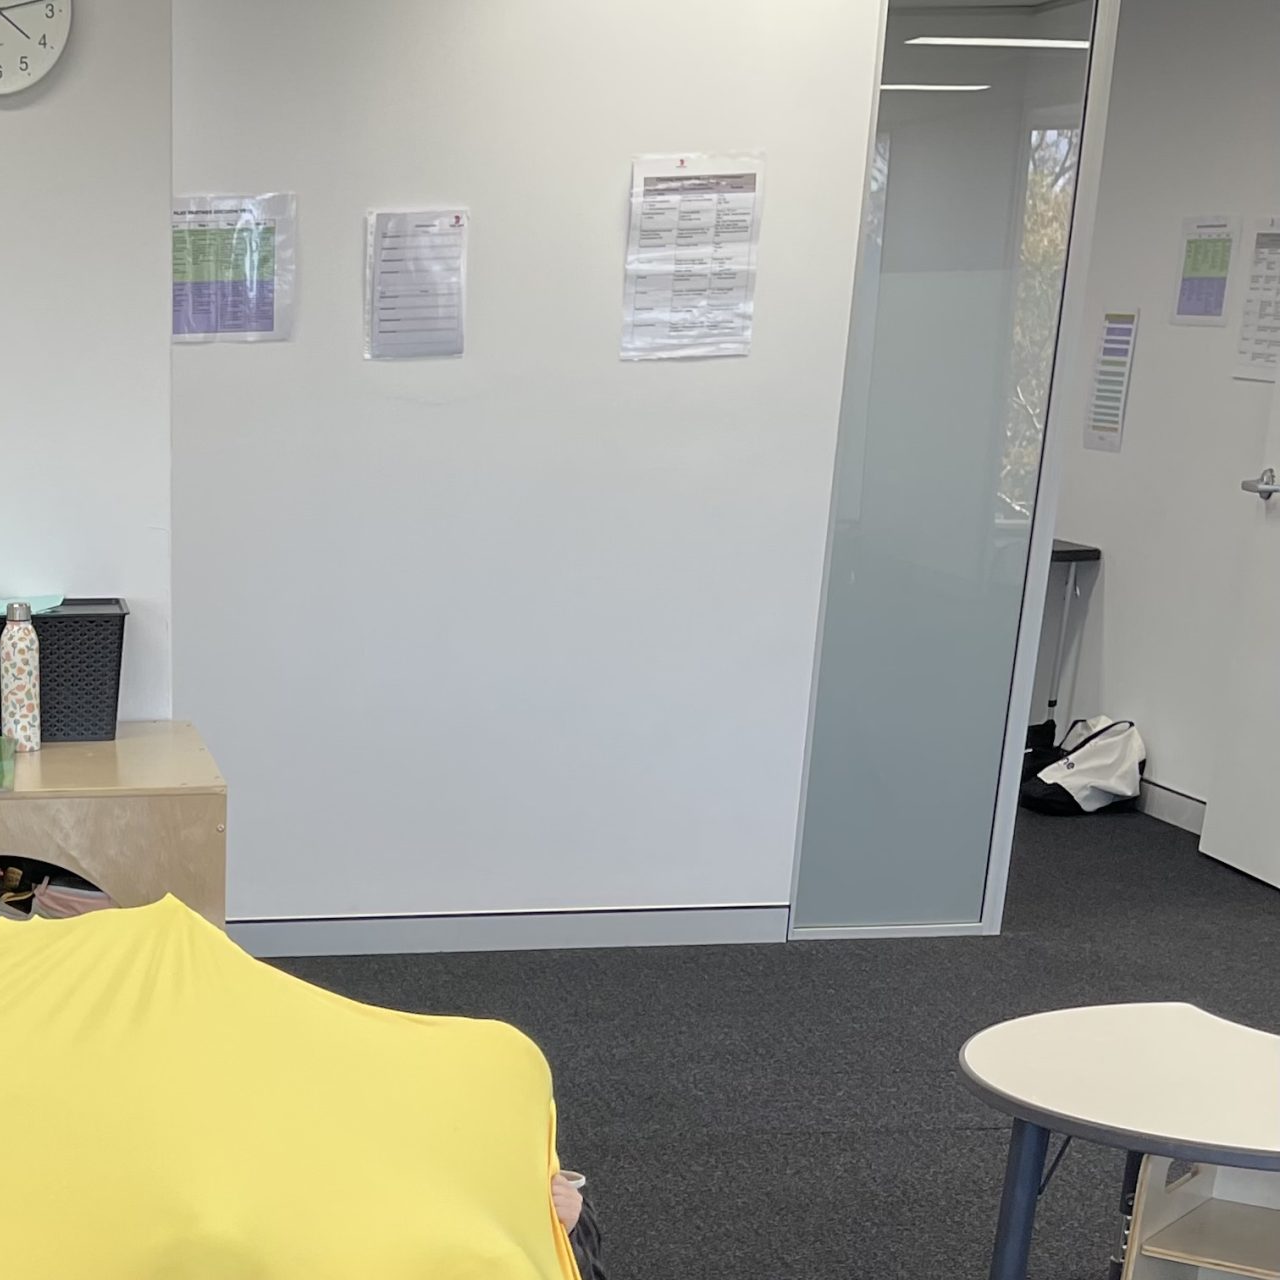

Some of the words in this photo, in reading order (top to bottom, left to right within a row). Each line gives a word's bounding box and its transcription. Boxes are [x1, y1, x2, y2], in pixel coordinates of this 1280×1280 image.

[45, 3, 55, 19] 3
[38, 33, 47, 49] 4
[19, 56, 29, 71] 5
